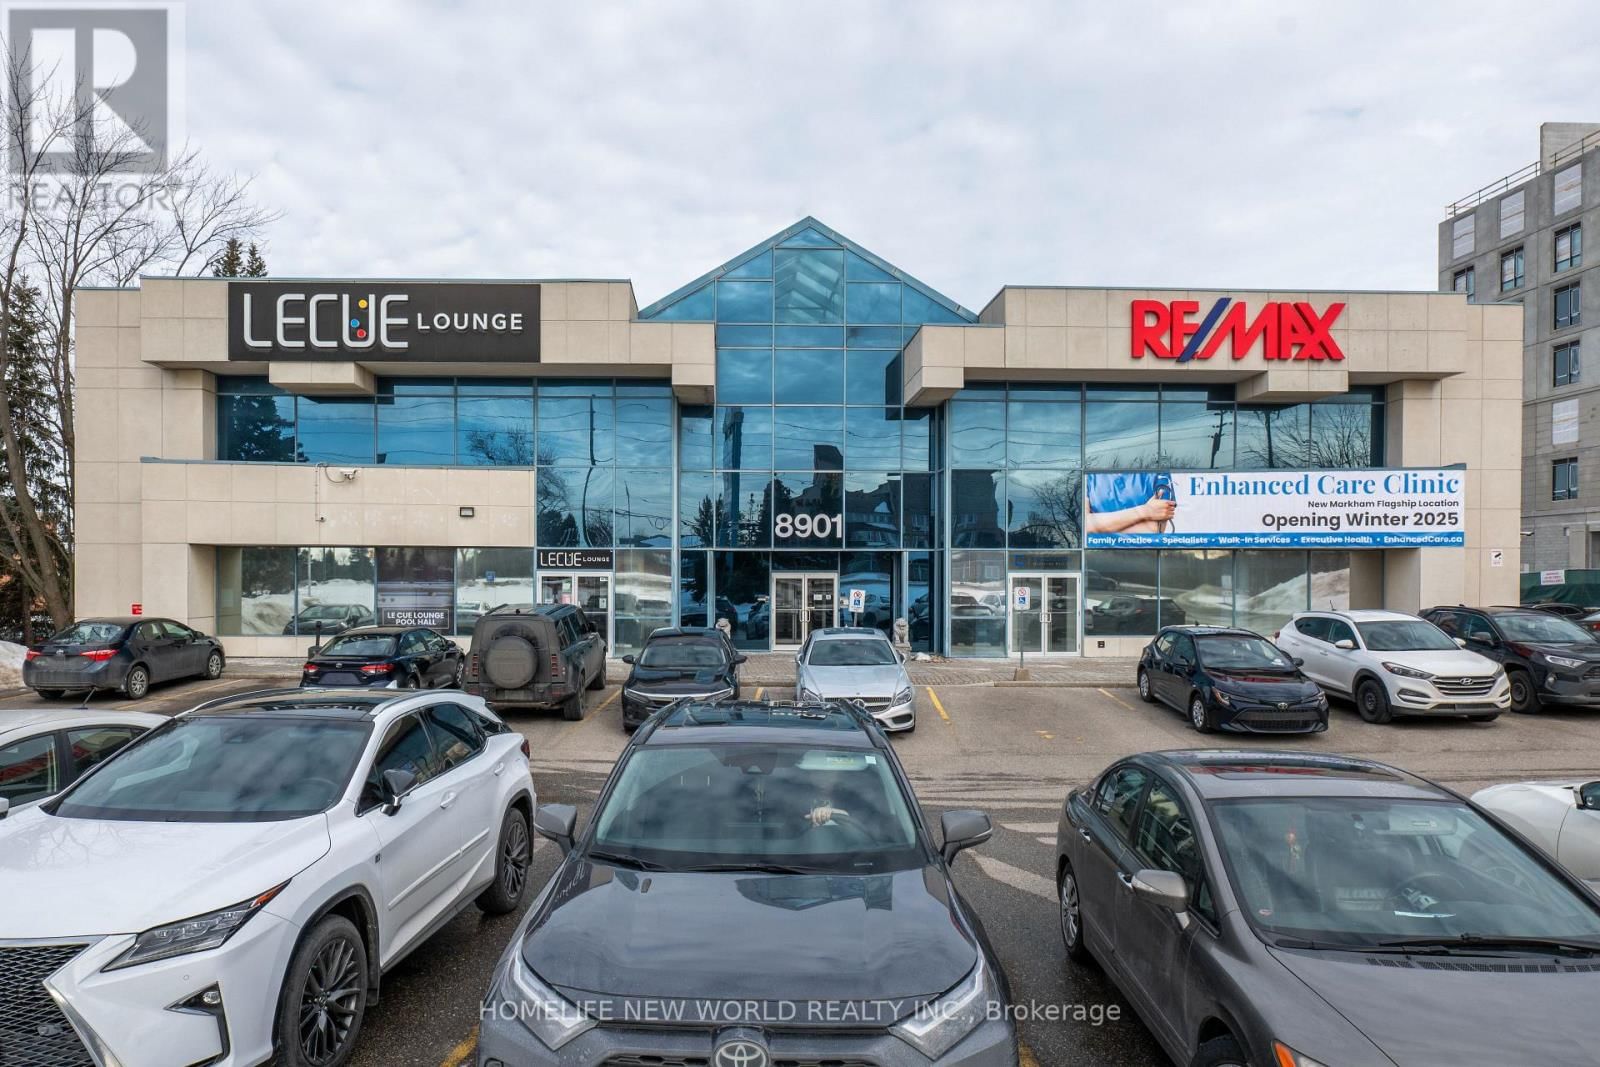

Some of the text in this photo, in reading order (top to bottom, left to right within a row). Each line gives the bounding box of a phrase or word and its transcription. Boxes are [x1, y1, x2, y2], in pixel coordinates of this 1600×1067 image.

[243, 293, 523, 348] LECUE LOUNGE
[1131, 297, 1346, 362] RE/MAX
[1190, 472, 1459, 496] Enhanced Care Clinic
[1329, 500, 1375, 508] Markham
[1376, 500, 1417, 510] Flagship
[1418, 499, 1459, 507] Location
[775, 513, 842, 538] 8901
[1262, 511, 1458, 531] Opening Winter 2025
[1088, 536, 1116, 545] Family
[1118, 536, 1152, 544] Practice
[1162, 536, 1208, 545] Specialists
[1218, 536, 1253, 544] Walk-In
[1301, 536, 1343, 544] Executive
[1344, 536, 1373, 544] Health
[1383, 535, 1463, 543] EnhancedCare.ca
[540, 552, 582, 567] LECUE
